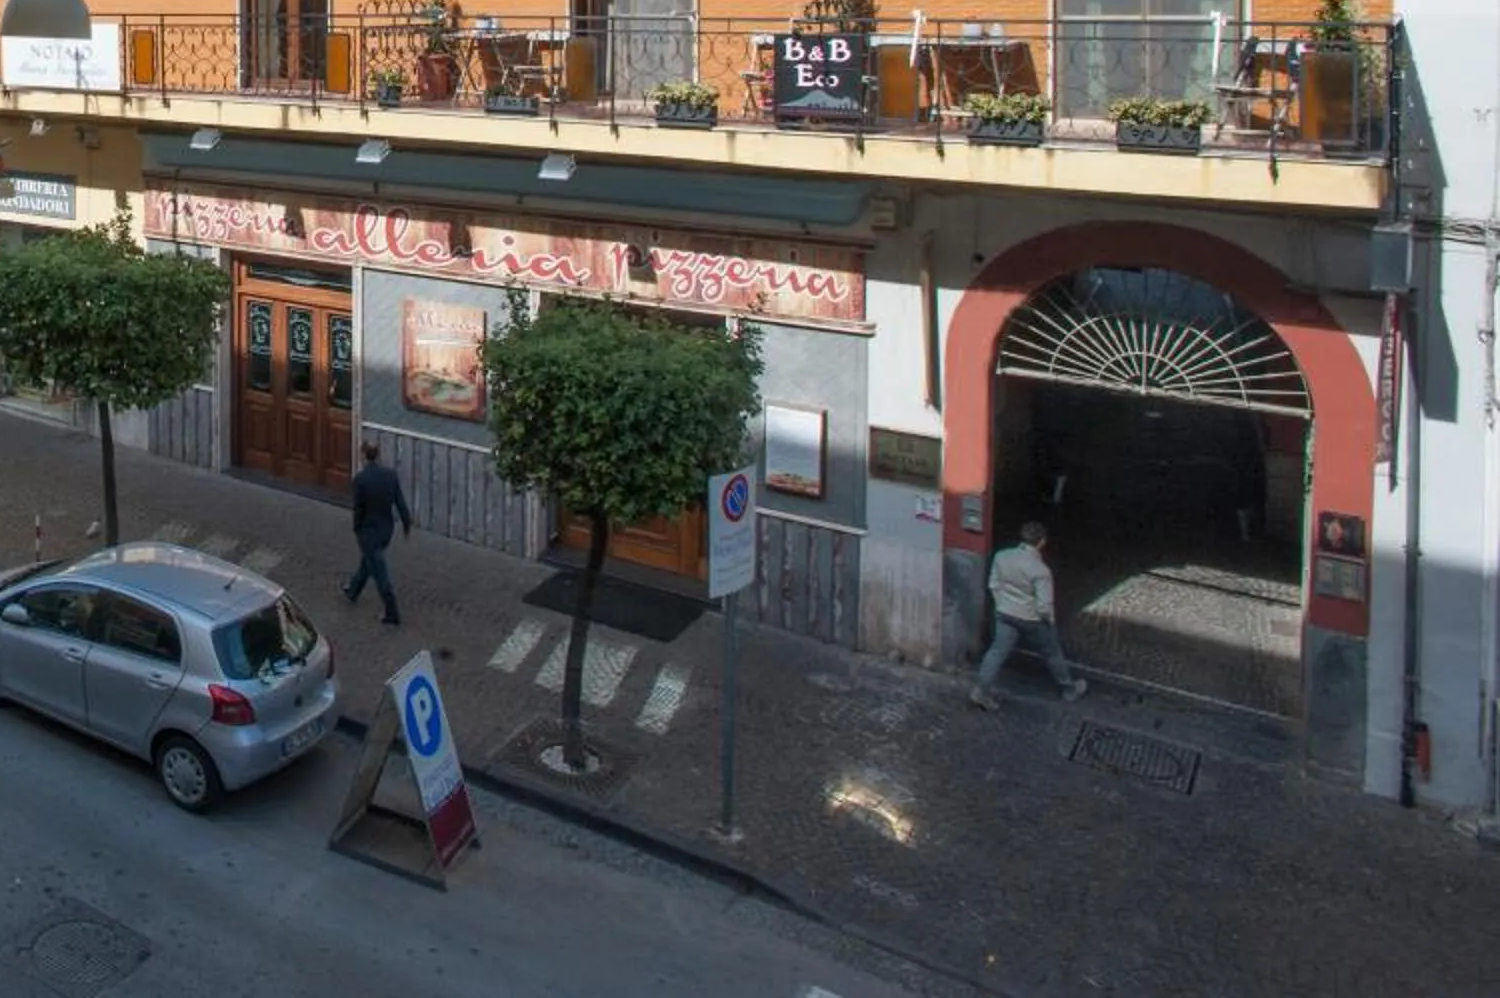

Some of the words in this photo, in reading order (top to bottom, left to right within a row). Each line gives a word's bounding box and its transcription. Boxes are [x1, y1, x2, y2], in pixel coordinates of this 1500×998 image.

[783, 38, 852, 62] B&B
[794, 64, 839, 87] Eco
[611, 233, 849, 303] pizzeria
[409, 686, 434, 747] P
